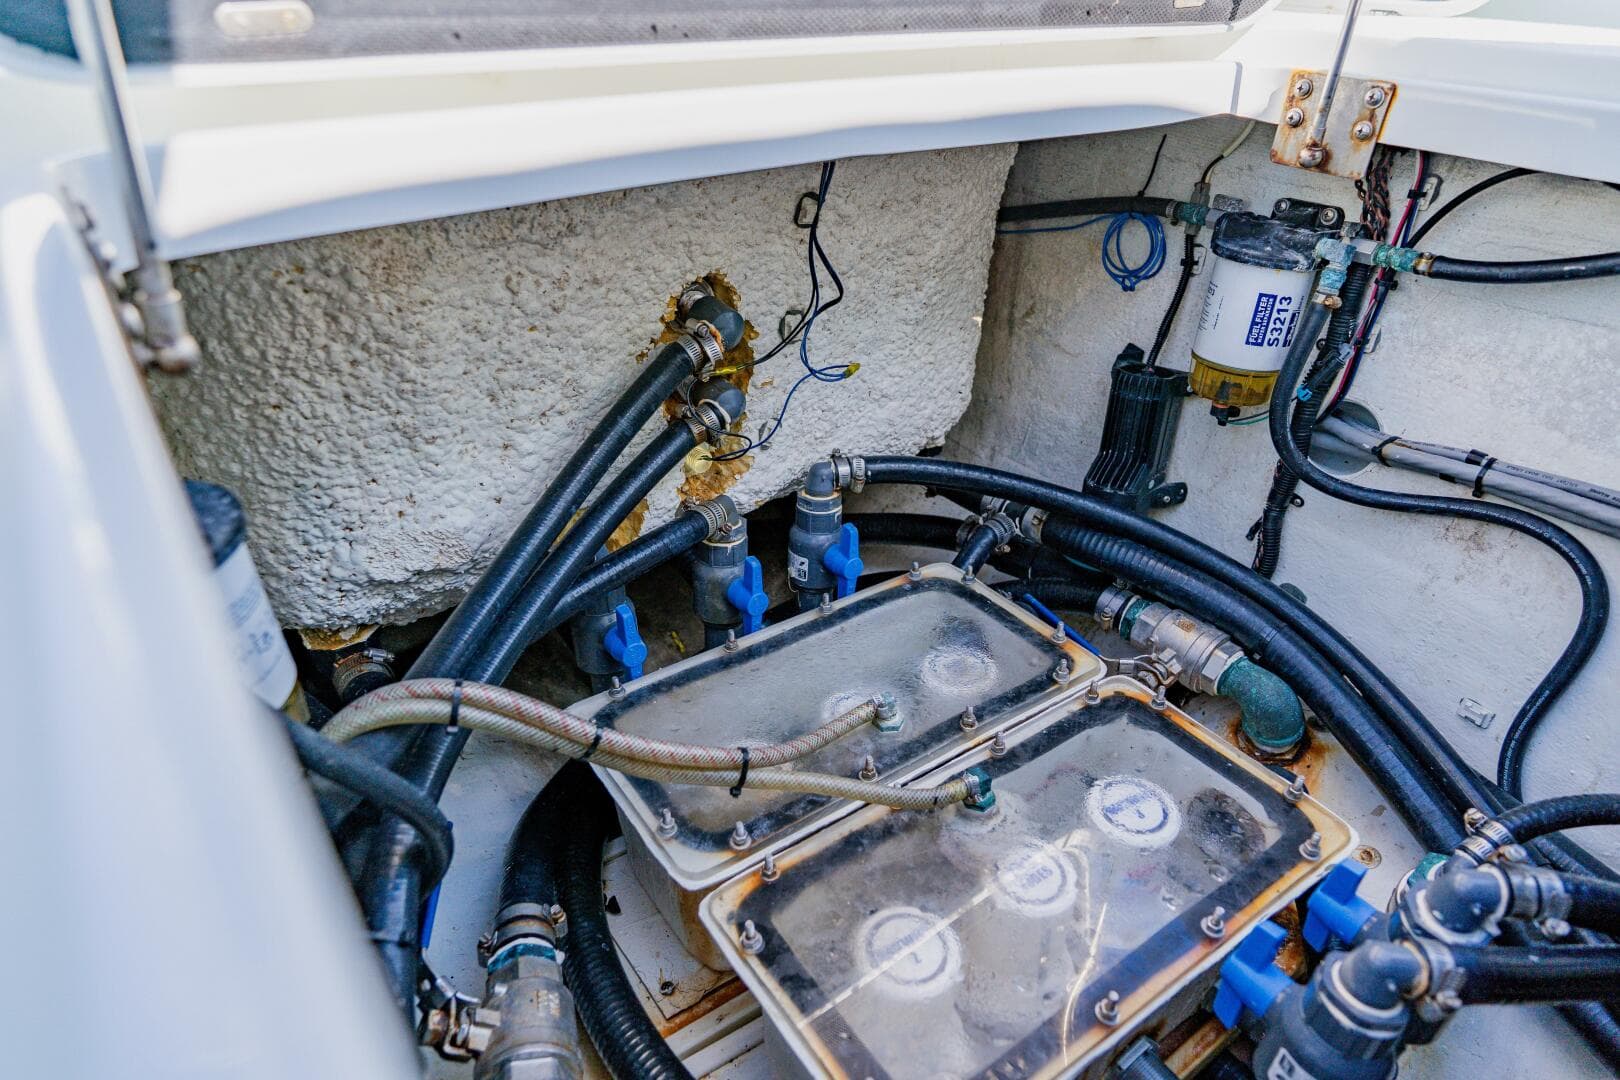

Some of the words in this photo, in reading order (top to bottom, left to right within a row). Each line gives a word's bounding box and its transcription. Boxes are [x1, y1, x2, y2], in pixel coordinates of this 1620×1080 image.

[1249, 322, 1261, 342] FUEL
[1255, 296, 1268, 322] FILTER
[1267, 296, 1292, 347] S3213
